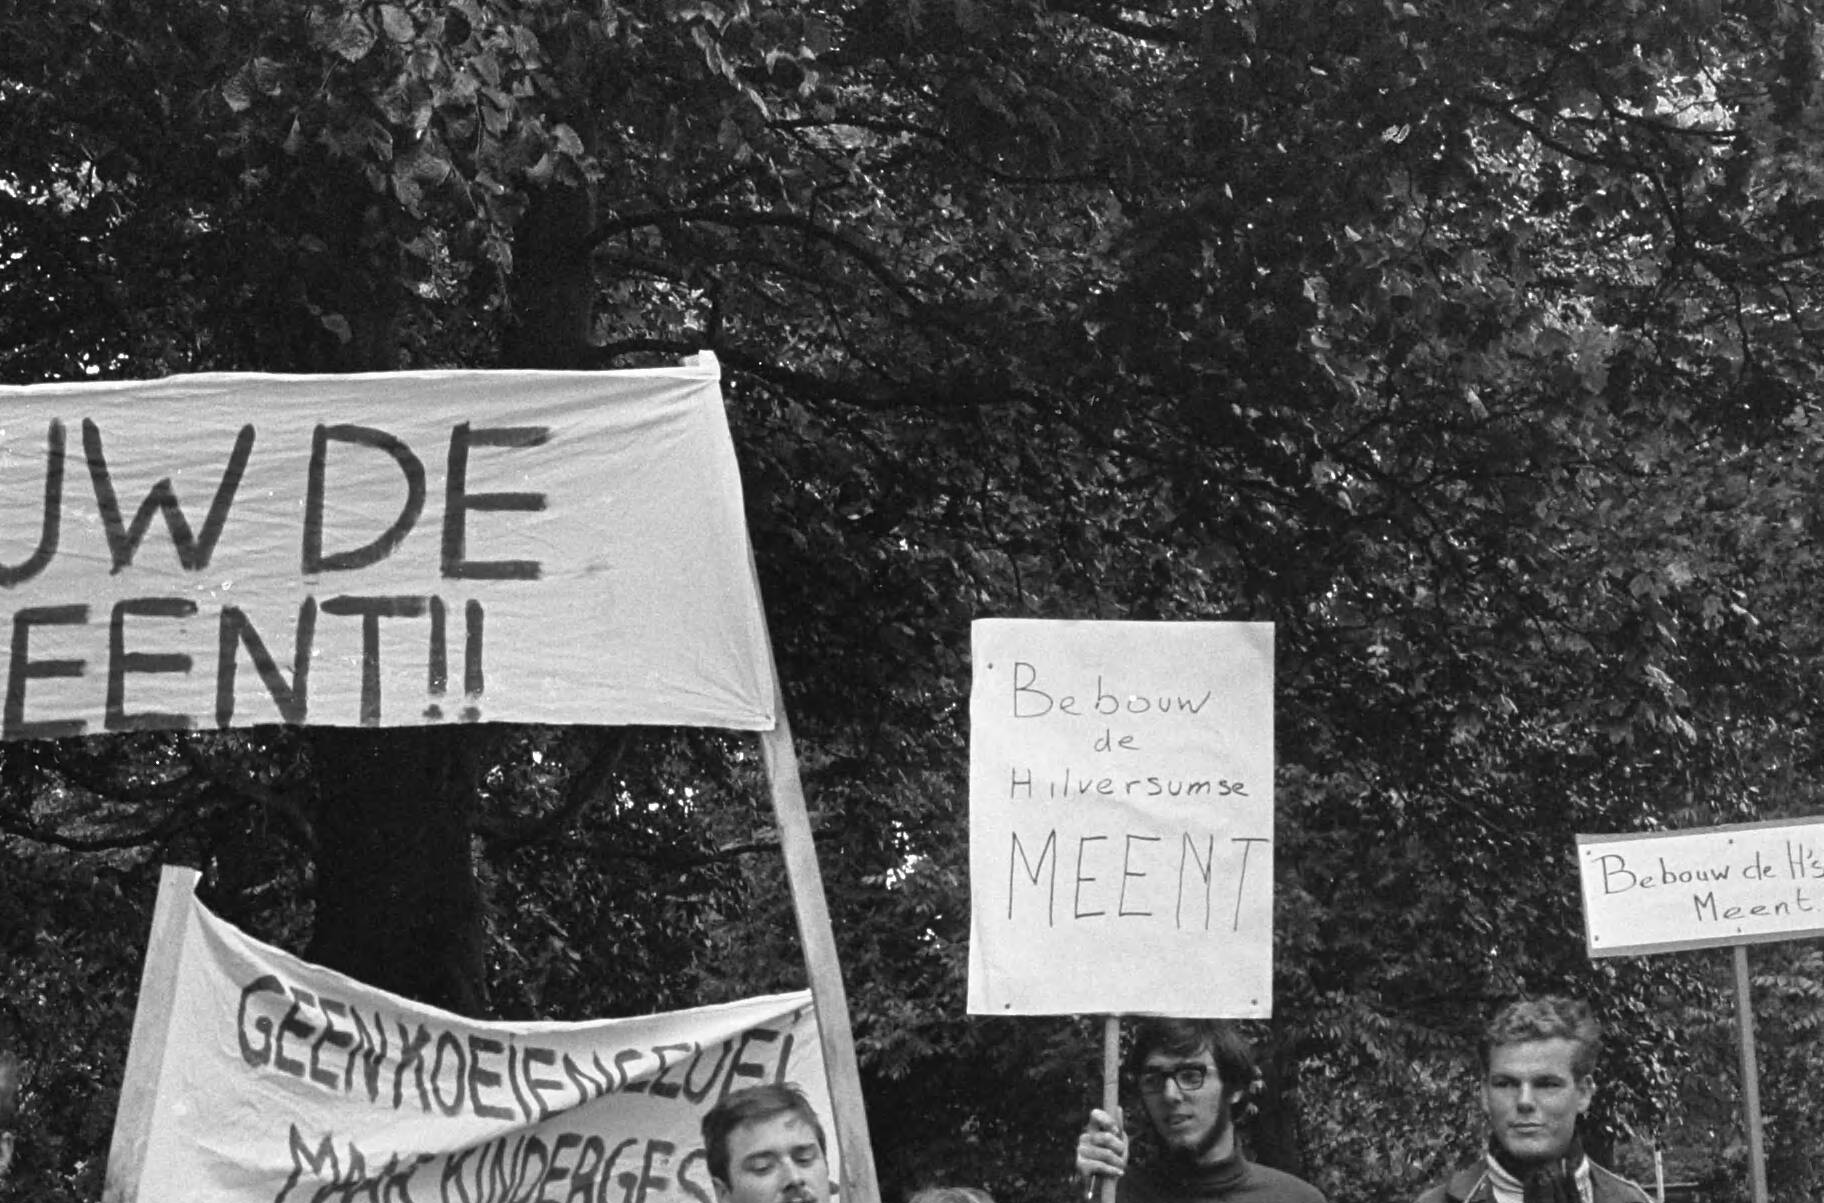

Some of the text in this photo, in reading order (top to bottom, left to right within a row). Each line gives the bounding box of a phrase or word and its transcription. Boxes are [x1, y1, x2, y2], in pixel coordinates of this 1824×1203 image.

[302, 421, 550, 581] DE
[1014, 661, 1212, 719] Bebouw
[1093, 728, 1142, 753] de
[1010, 766, 1250, 799] Hilversumse
[1008, 828, 1271, 932] MEENT
[1591, 853, 1730, 894] Bebouw
[1743, 850, 1777, 881] de
[238, 974, 388, 1104] GEEN
